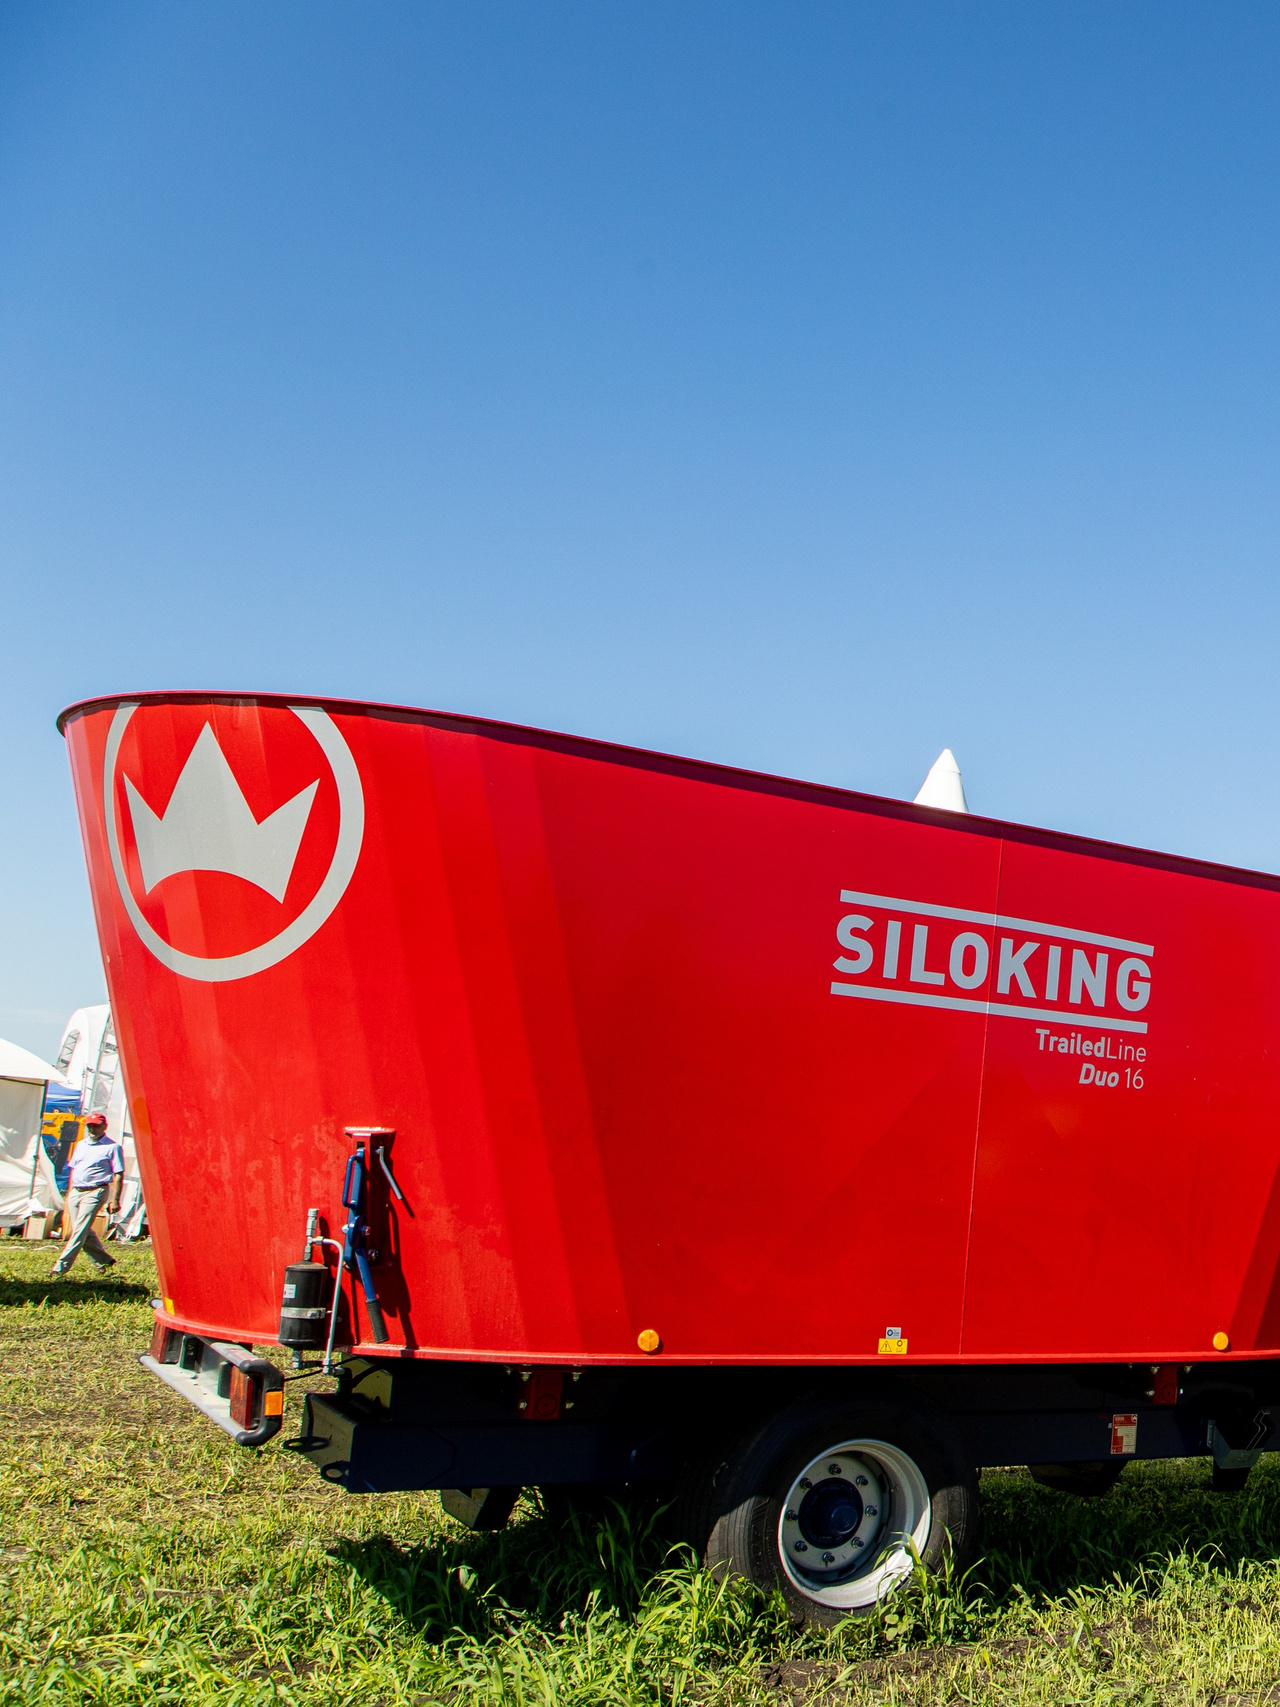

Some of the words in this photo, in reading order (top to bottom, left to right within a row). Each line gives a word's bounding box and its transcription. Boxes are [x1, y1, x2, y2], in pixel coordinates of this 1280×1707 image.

[832, 914, 1152, 1012] SILOKING
[1035, 1028, 1147, 1063] TrailedLine
[1079, 1062, 1120, 1088] Duo
[1124, 1067, 1145, 1090] 16
